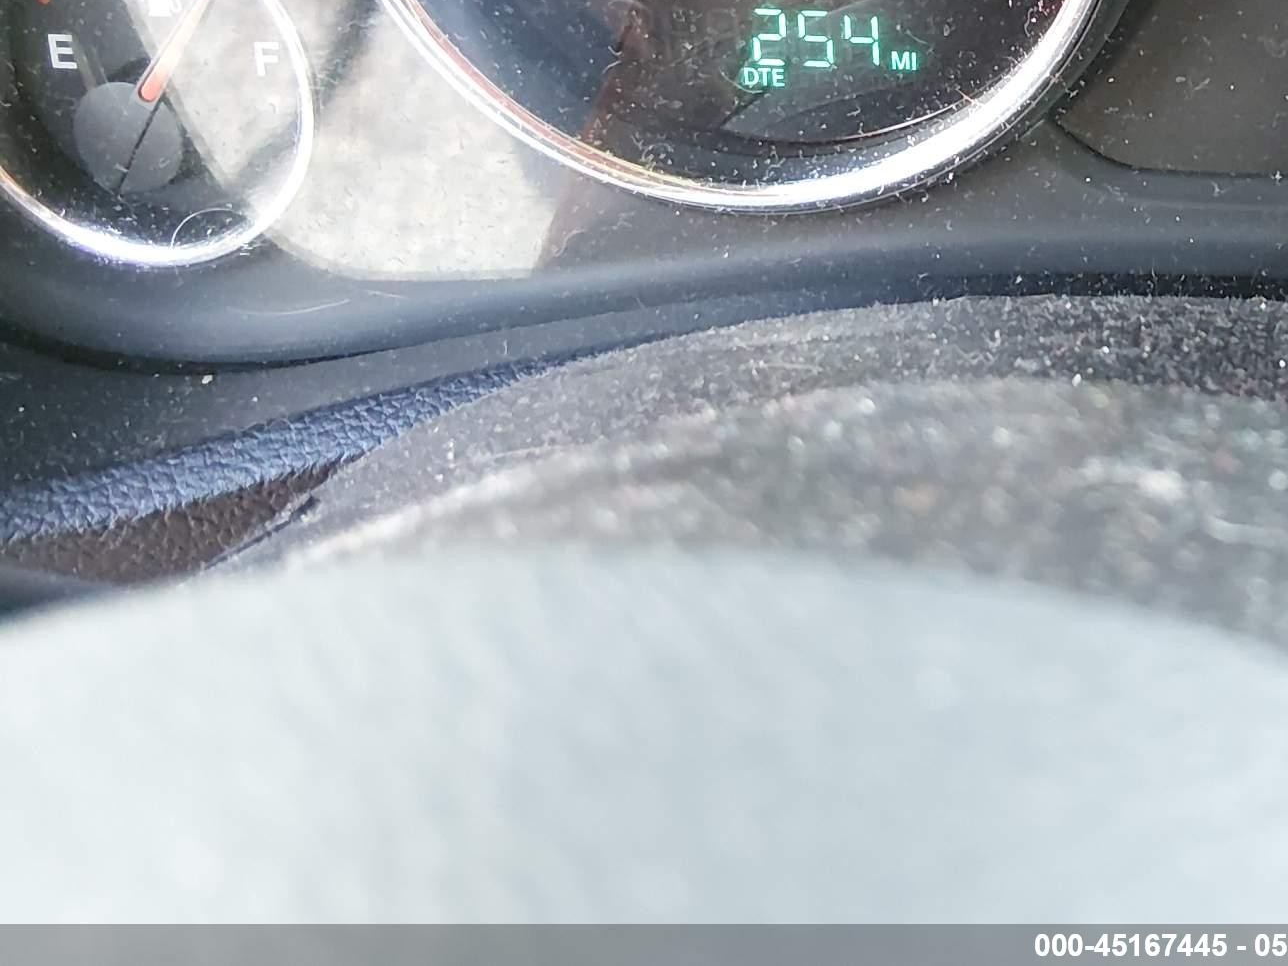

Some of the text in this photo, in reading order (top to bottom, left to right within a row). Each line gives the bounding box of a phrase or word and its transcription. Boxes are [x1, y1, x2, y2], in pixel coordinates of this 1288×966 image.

[47, 33, 78, 70] E
[752, 8, 917, 71] 254 MI
[253, 41, 280, 77] F
[742, 66, 786, 87] DTE
